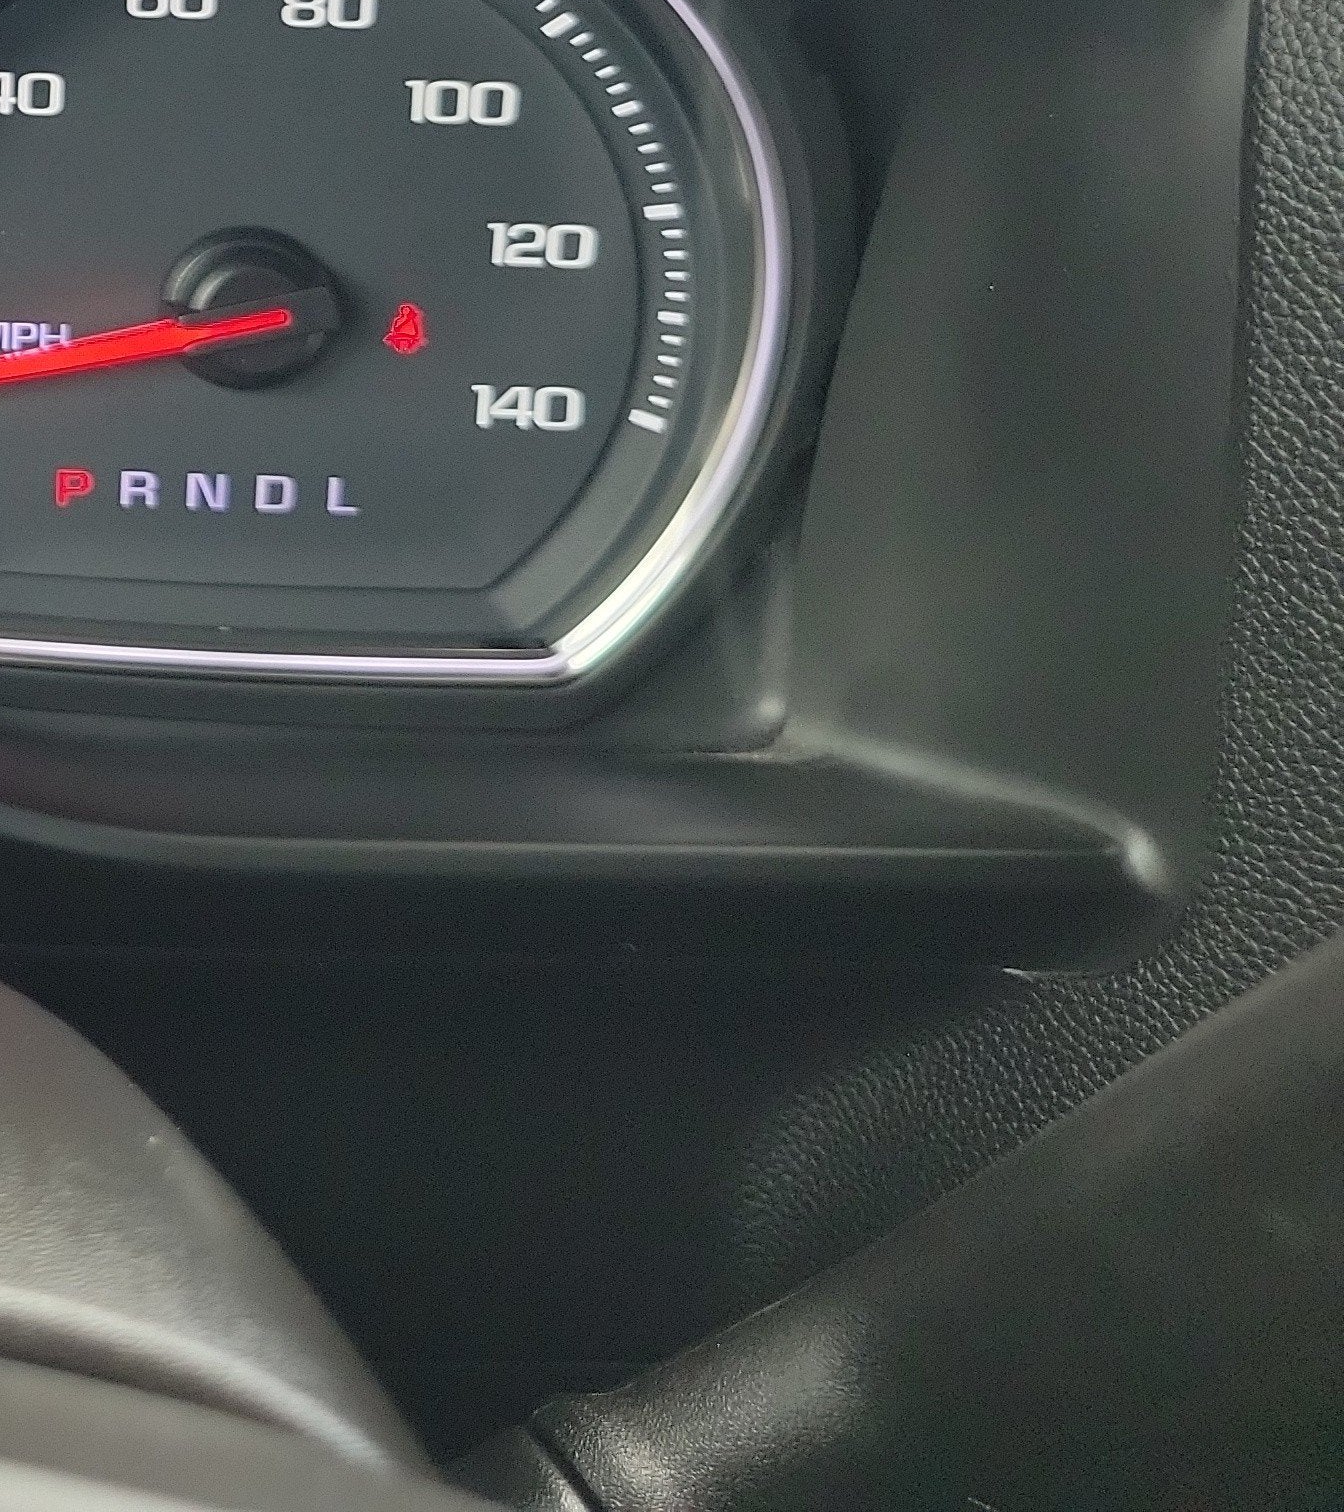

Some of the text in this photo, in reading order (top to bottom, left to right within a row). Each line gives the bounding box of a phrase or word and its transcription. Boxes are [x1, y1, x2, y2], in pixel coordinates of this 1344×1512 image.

[404, 79, 520, 127] 100
[487, 222, 599, 269] 120
[470, 384, 584, 431] 140
[54, 468, 359, 515] P R N D L
